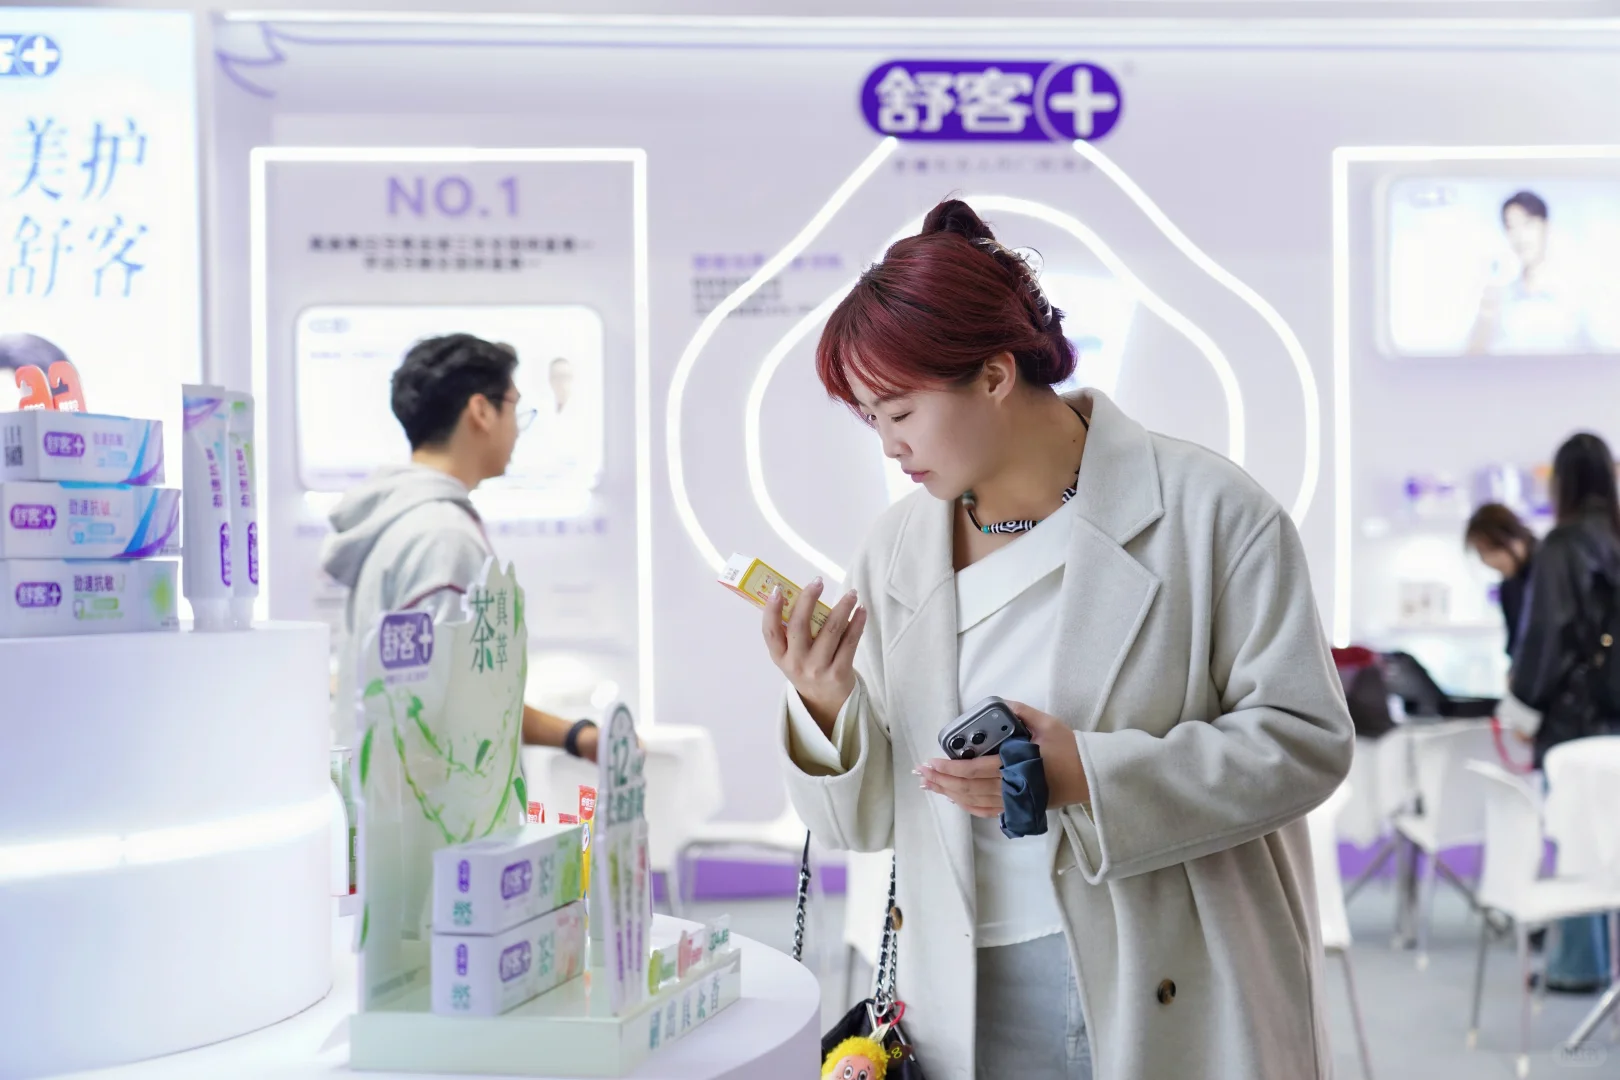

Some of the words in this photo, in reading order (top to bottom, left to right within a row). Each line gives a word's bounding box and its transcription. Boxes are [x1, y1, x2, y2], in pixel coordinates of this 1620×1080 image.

[10, 116, 147, 200] 美护
[386, 175, 520, 217] NO.1
[6, 213, 148, 298] 舒客
